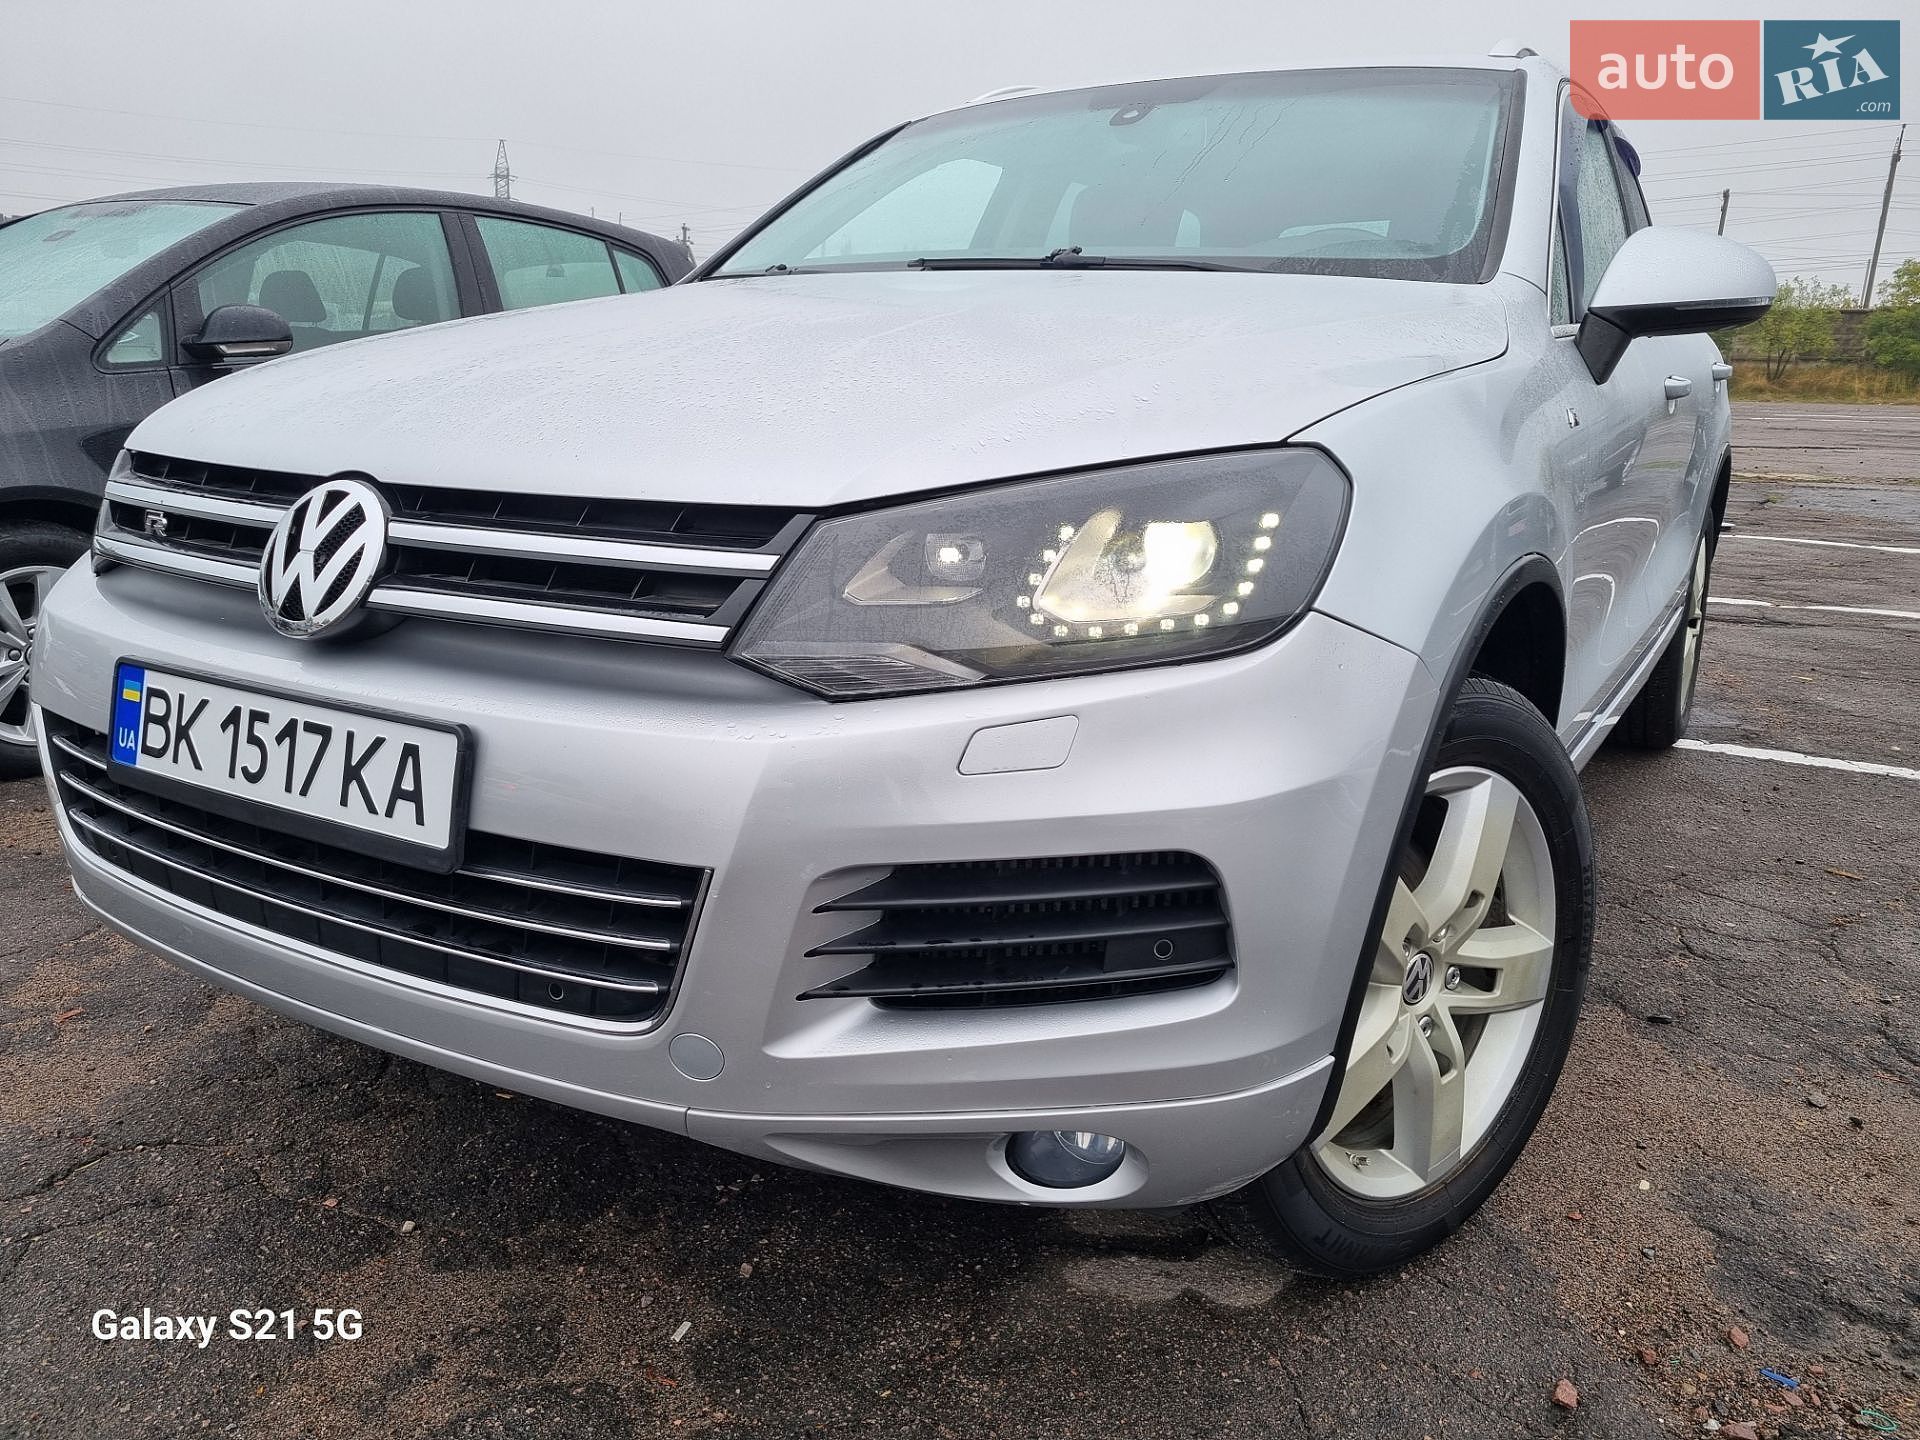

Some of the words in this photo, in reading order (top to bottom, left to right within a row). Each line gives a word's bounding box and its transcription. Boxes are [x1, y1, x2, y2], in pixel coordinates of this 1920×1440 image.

[145, 509, 168, 537] R
[118, 726, 136, 751] UA
[140, 686, 210, 772] BK
[219, 705, 333, 798] 1517
[339, 729, 426, 827] KA
